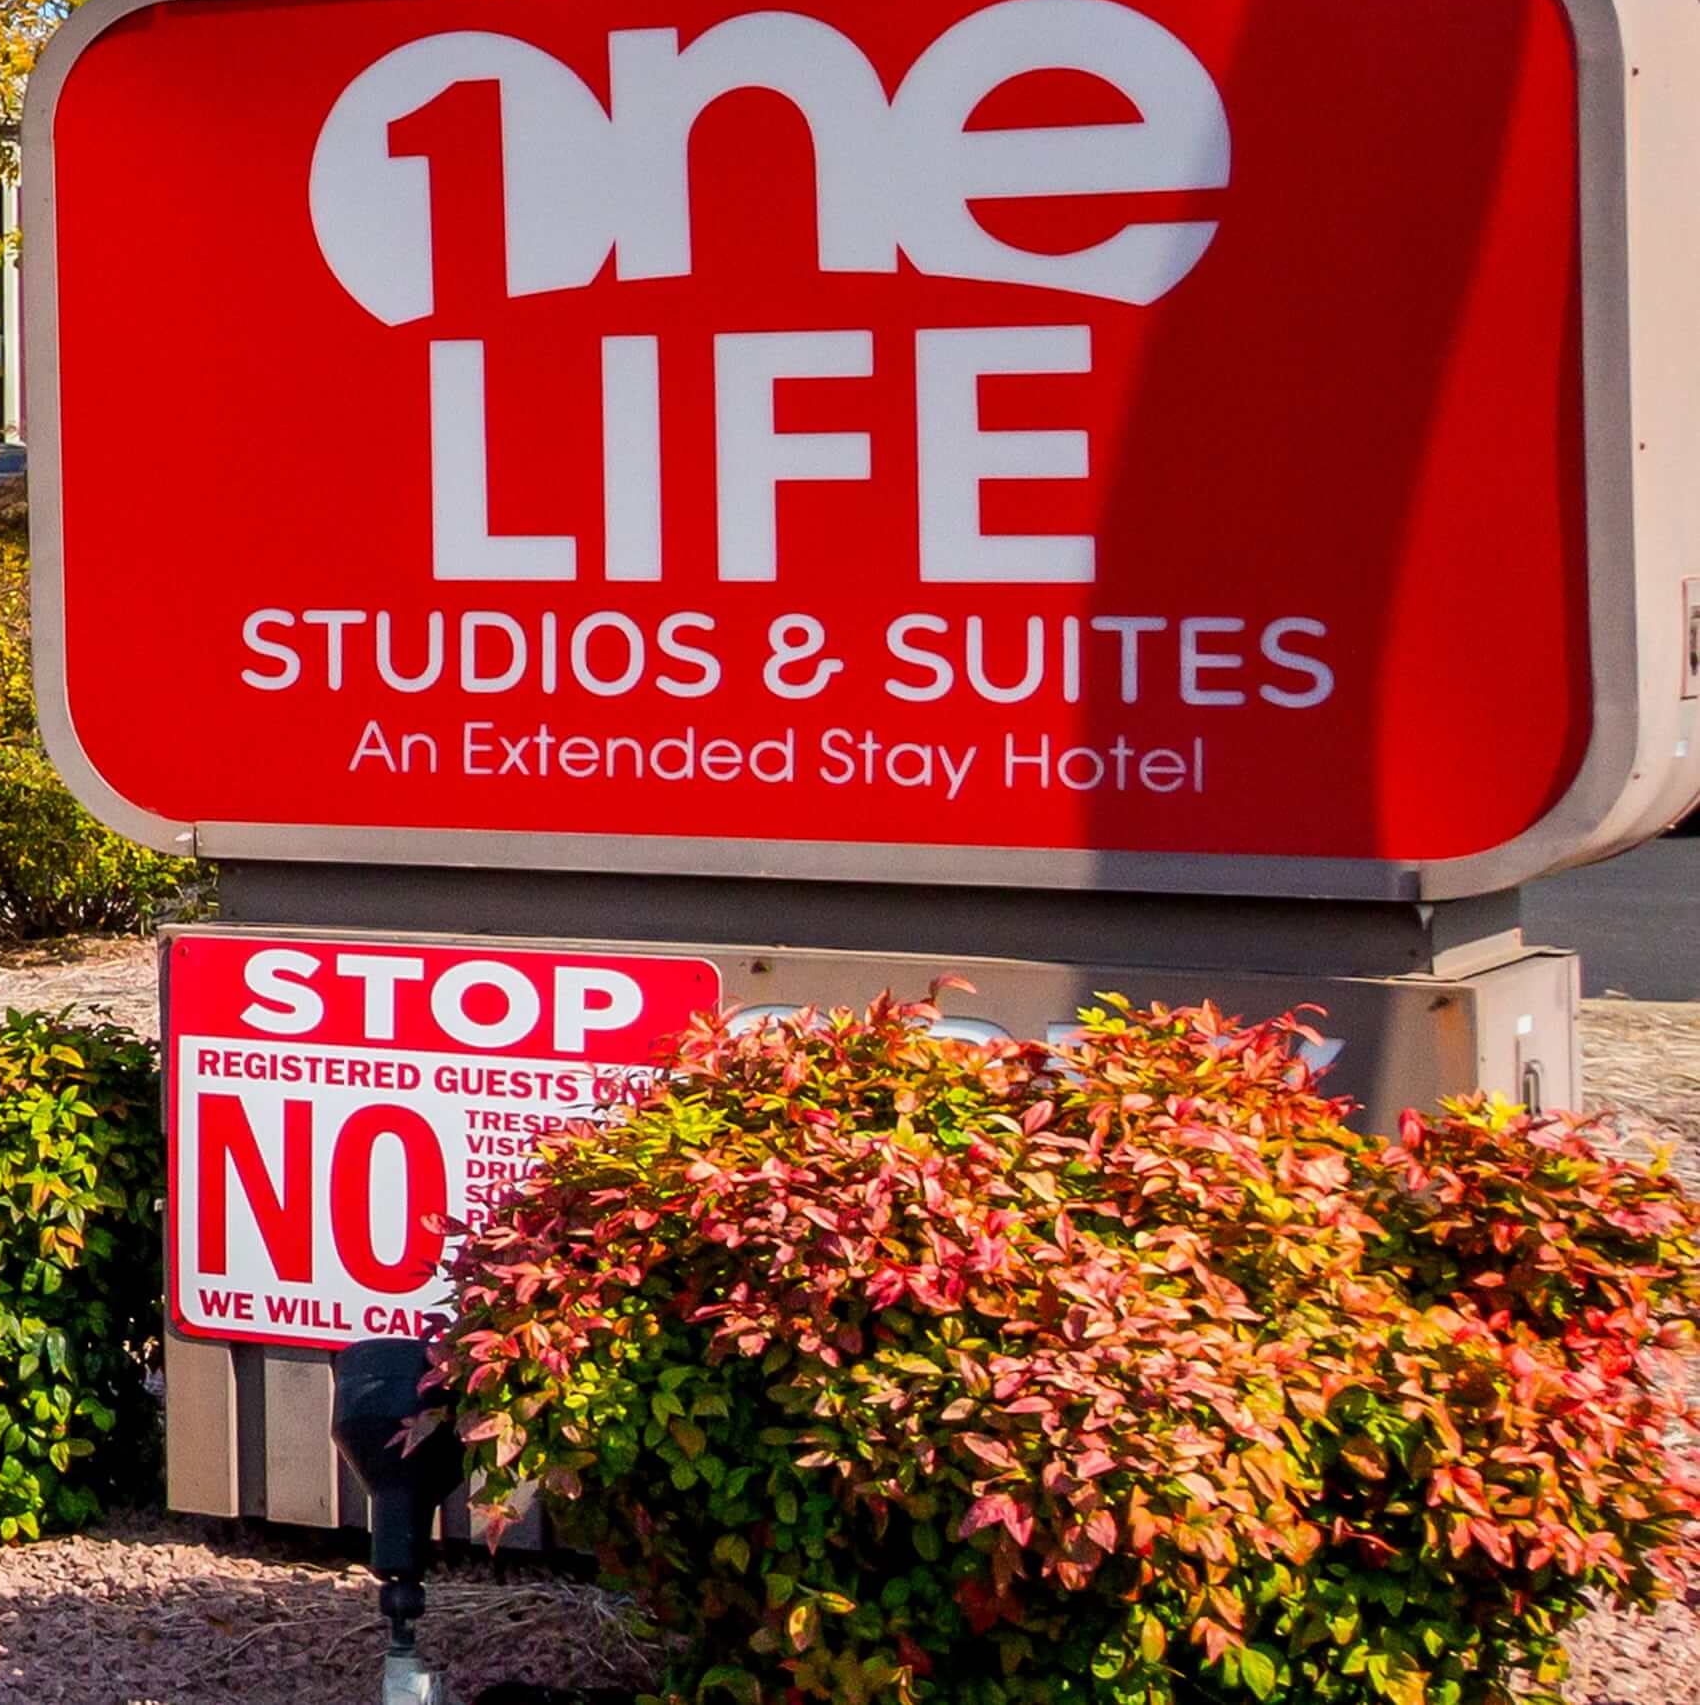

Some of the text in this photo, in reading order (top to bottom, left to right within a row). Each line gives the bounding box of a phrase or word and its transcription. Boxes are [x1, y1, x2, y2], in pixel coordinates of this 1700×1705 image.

[430, 326, 1095, 582] LIFE
[242, 609, 1333, 707] STUDIOS & SUITES
[351, 722, 1202, 798] An Extended Stay Hotel
[240, 948, 643, 1053] STOP
[198, 1049, 421, 1091] REGISTERED
[434, 1065, 578, 1103] GUESTS
[198, 1092, 448, 1294] NO
[199, 1289, 253, 1321] WE
[264, 1295, 351, 1330] WILL
